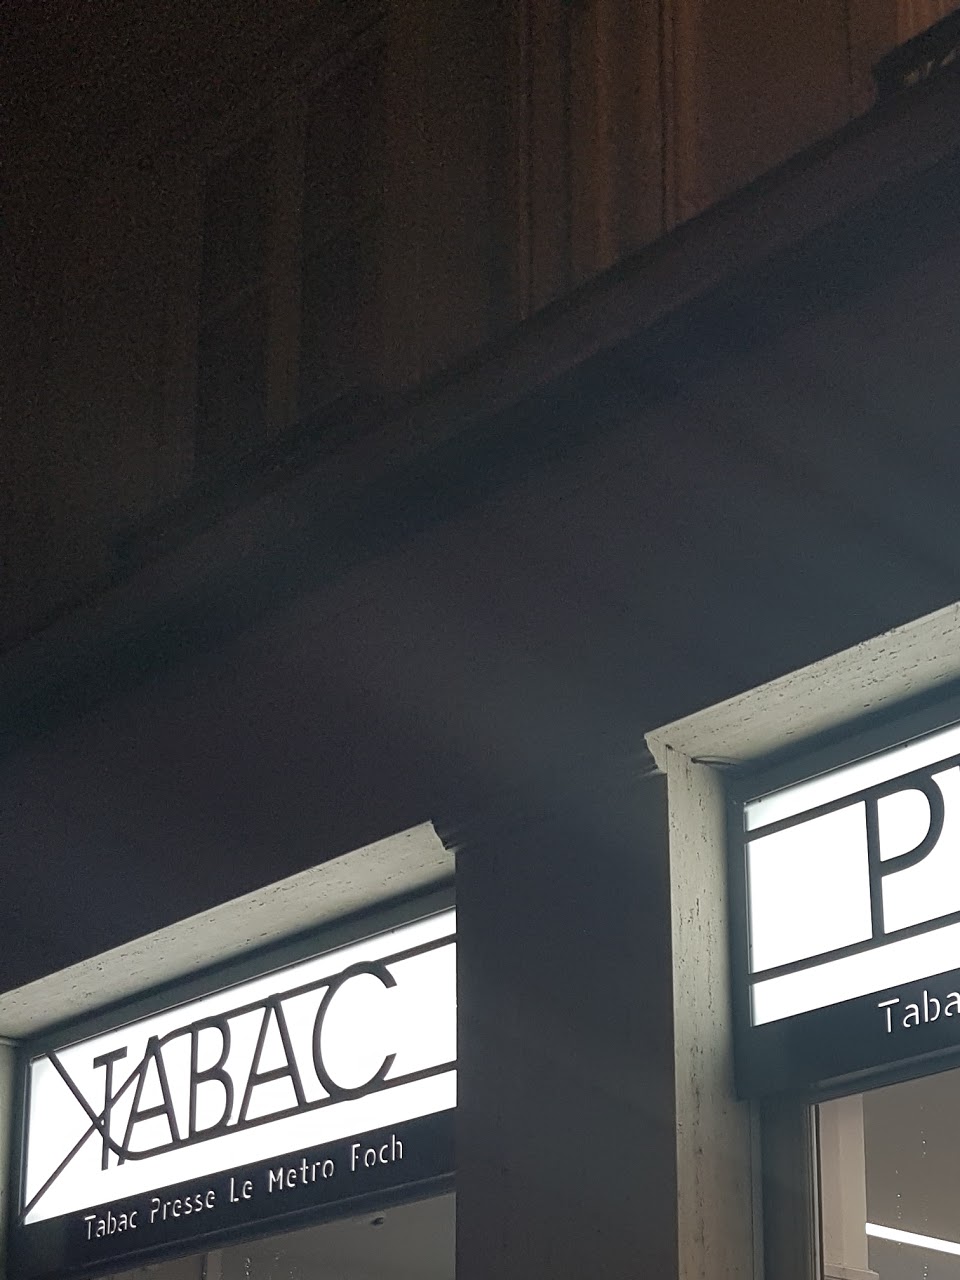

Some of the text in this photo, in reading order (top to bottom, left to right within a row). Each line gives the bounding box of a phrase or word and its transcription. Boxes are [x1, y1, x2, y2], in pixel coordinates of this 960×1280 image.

[93, 960, 398, 1171] TABAC
[84, 1134, 404, 1241] Tabac Presse Le Metro Foch
